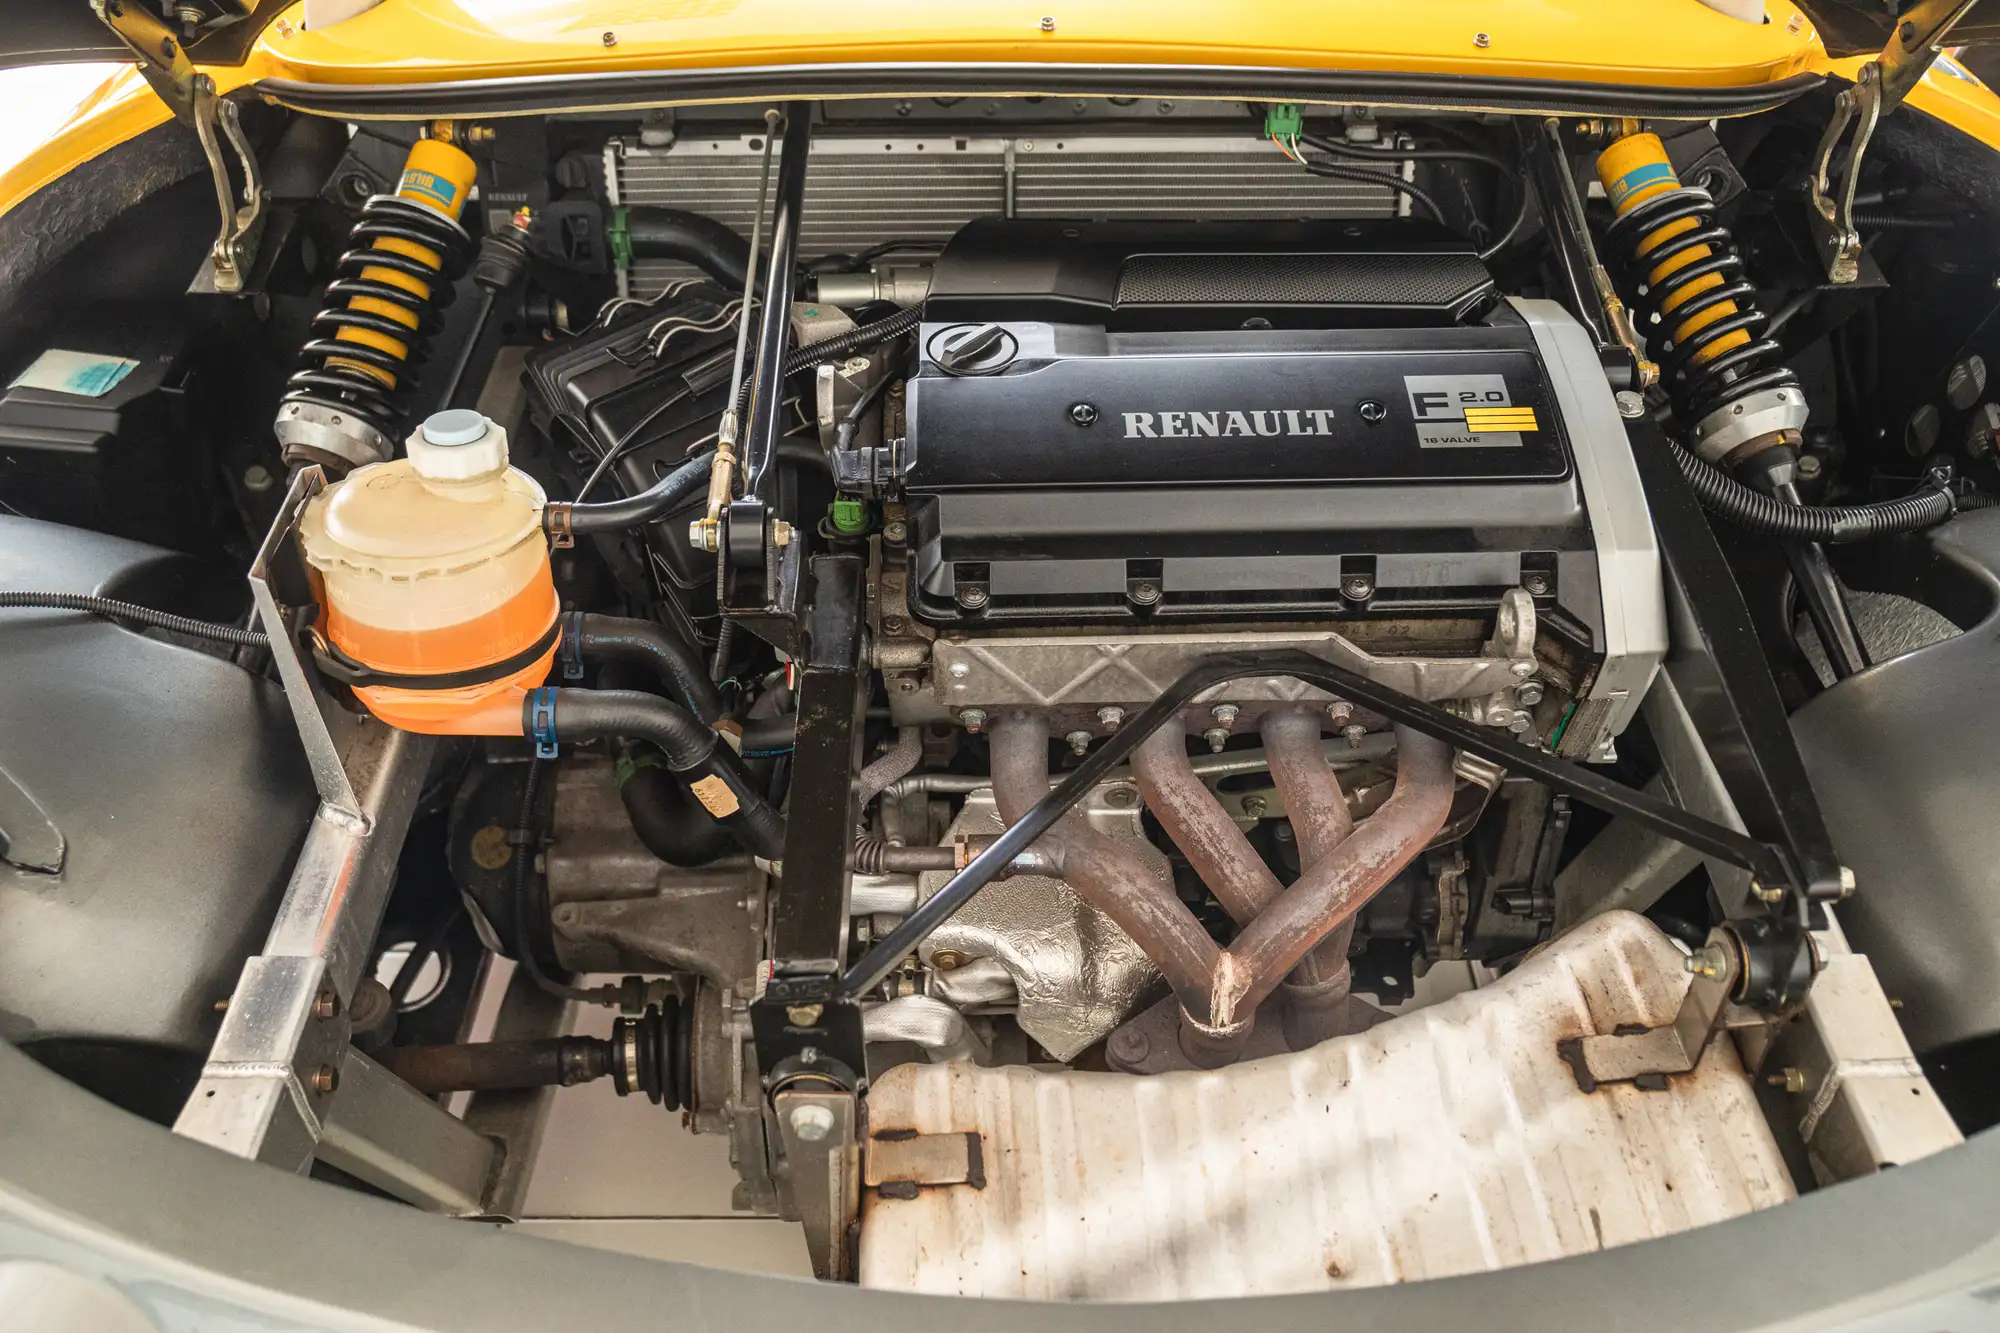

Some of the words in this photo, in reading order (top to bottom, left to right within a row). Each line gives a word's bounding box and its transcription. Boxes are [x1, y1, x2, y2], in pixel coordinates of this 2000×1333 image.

[1412, 392, 1450, 417] F
[1458, 391, 1505, 403] 2.0
[1121, 409, 1335, 438] RENAULT
[1423, 437, 1439, 445] 16
[1440, 436, 1481, 444] VALVE
